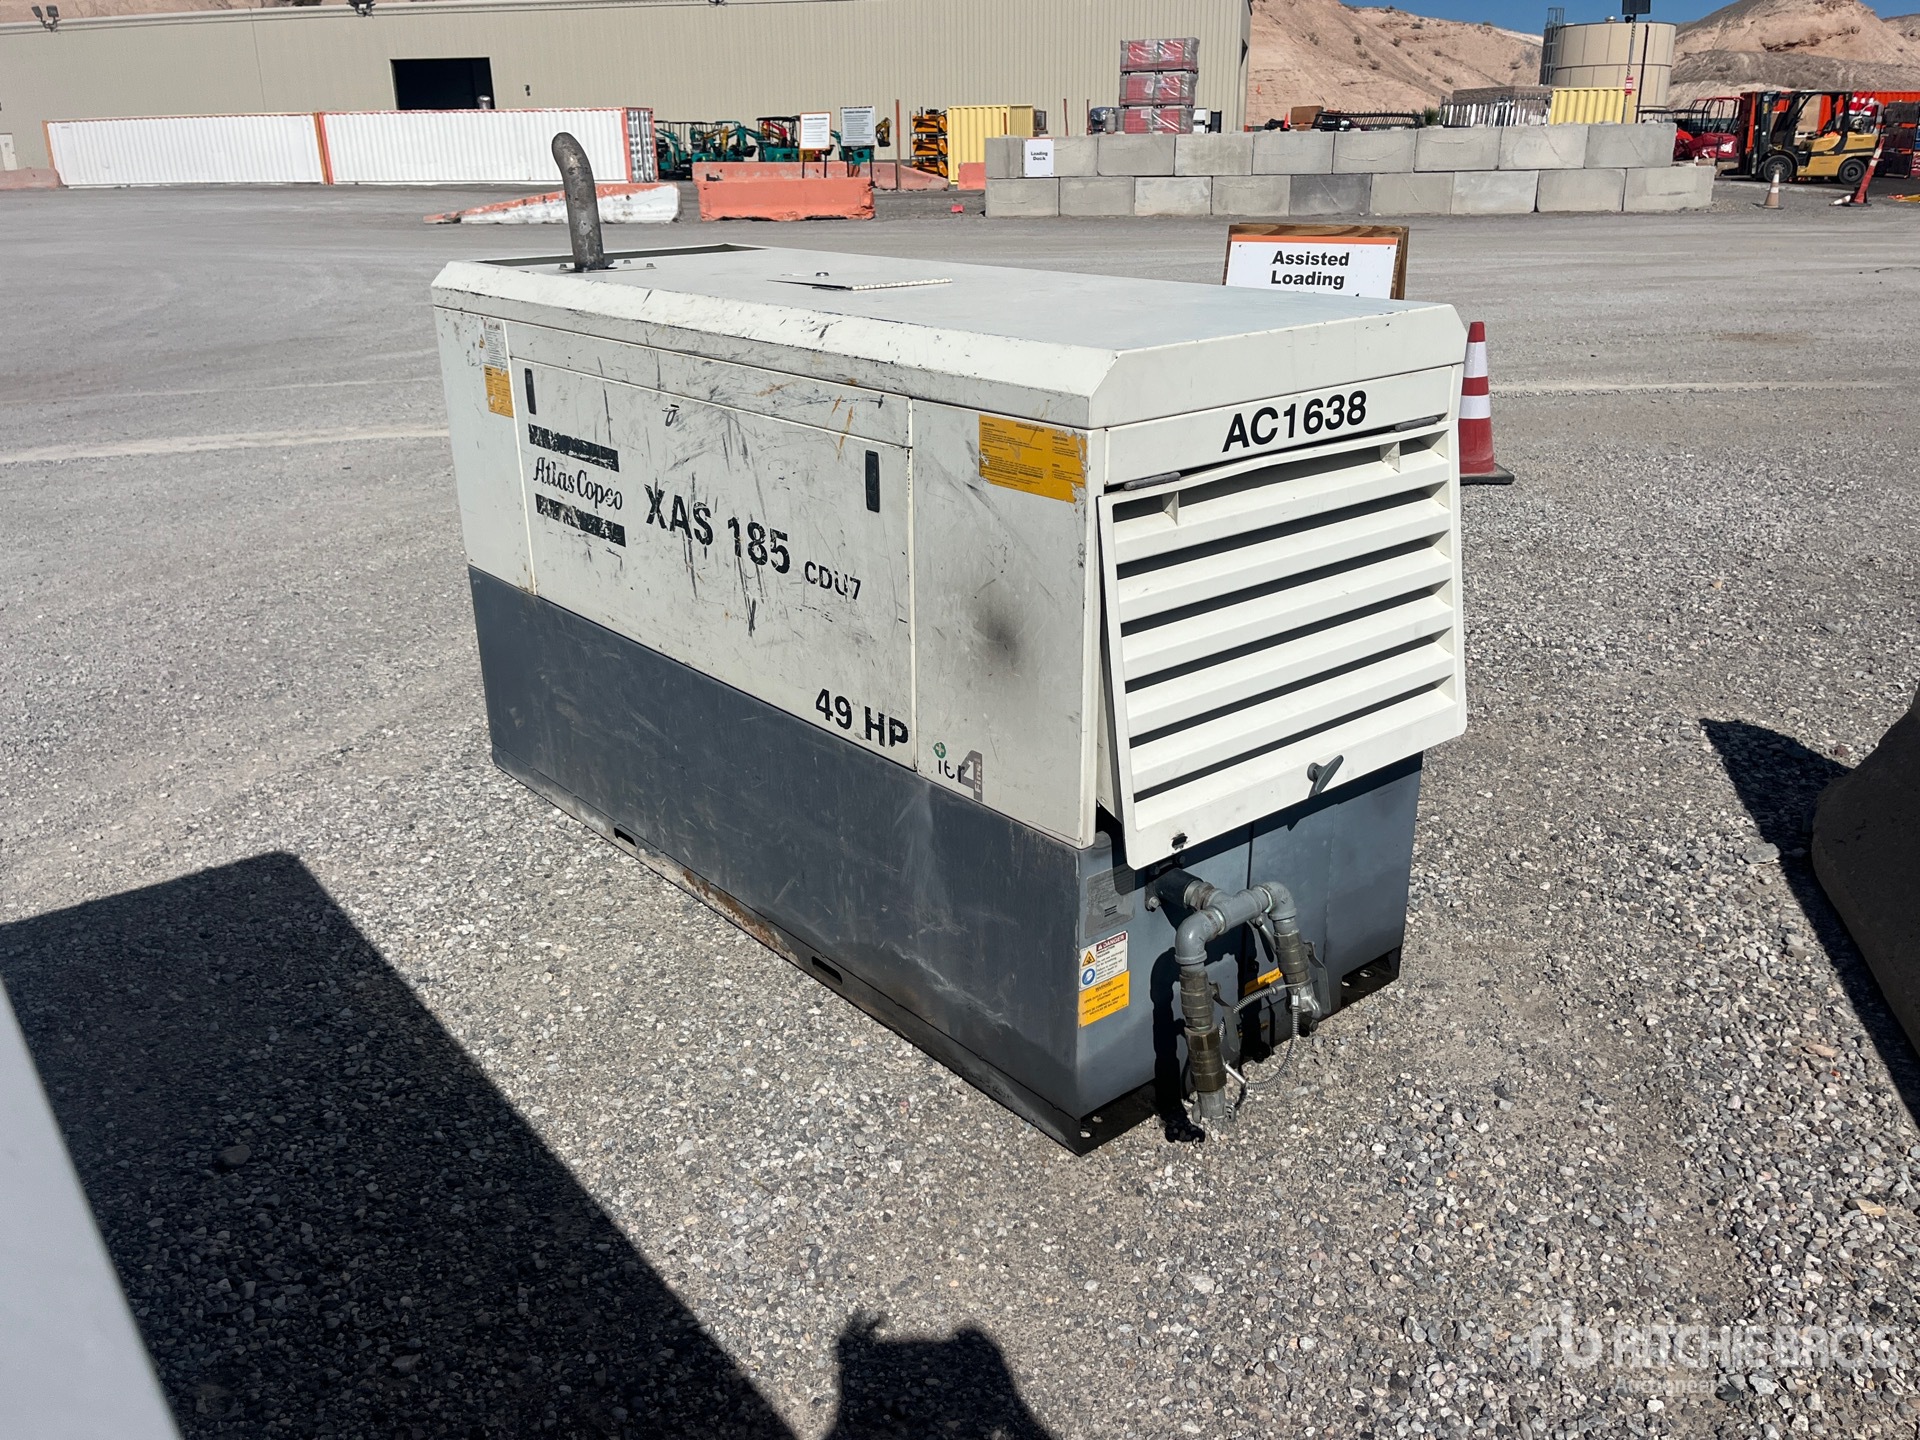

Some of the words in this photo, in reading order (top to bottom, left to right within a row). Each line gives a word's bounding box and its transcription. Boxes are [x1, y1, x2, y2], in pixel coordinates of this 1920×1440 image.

[1271, 270, 1345, 290] Loading
[1272, 250, 1350, 266] Assisted
[1222, 390, 1367, 453] AC1638
[533, 456, 575, 494] Atlas
[577, 469, 623, 512] Copco
[644, 483, 714, 546] XAS
[727, 517, 791, 574] 185
[815, 688, 853, 730] 49
[864, 706, 909, 748] HP
[1103, 935, 1126, 948] DANGER
